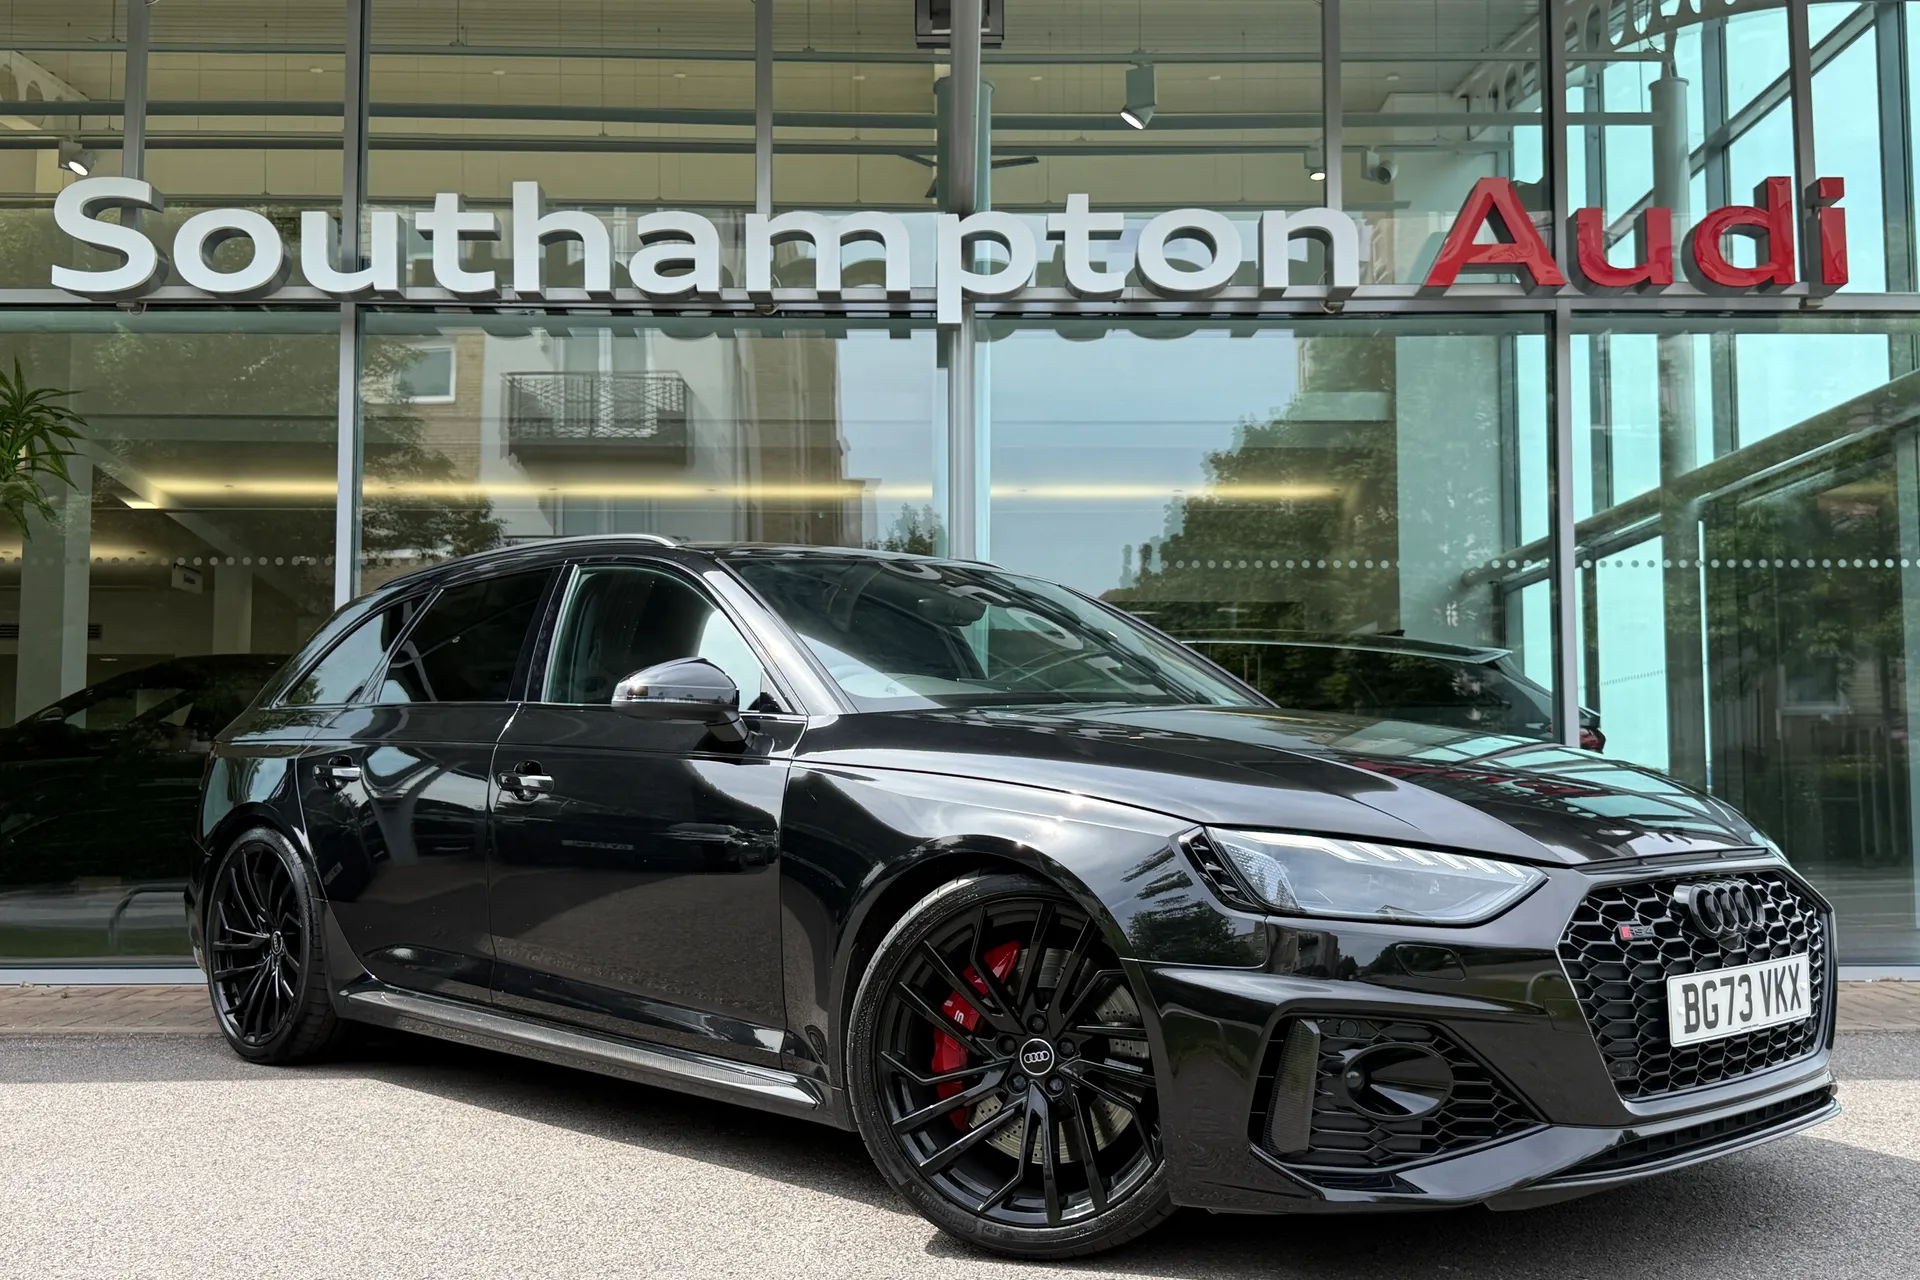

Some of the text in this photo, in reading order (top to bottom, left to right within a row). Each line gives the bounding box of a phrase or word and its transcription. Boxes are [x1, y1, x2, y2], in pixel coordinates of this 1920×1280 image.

[50, 176, 1848, 324] Southampton Audi
[1682, 963, 1802, 1034] BG73 VKX
